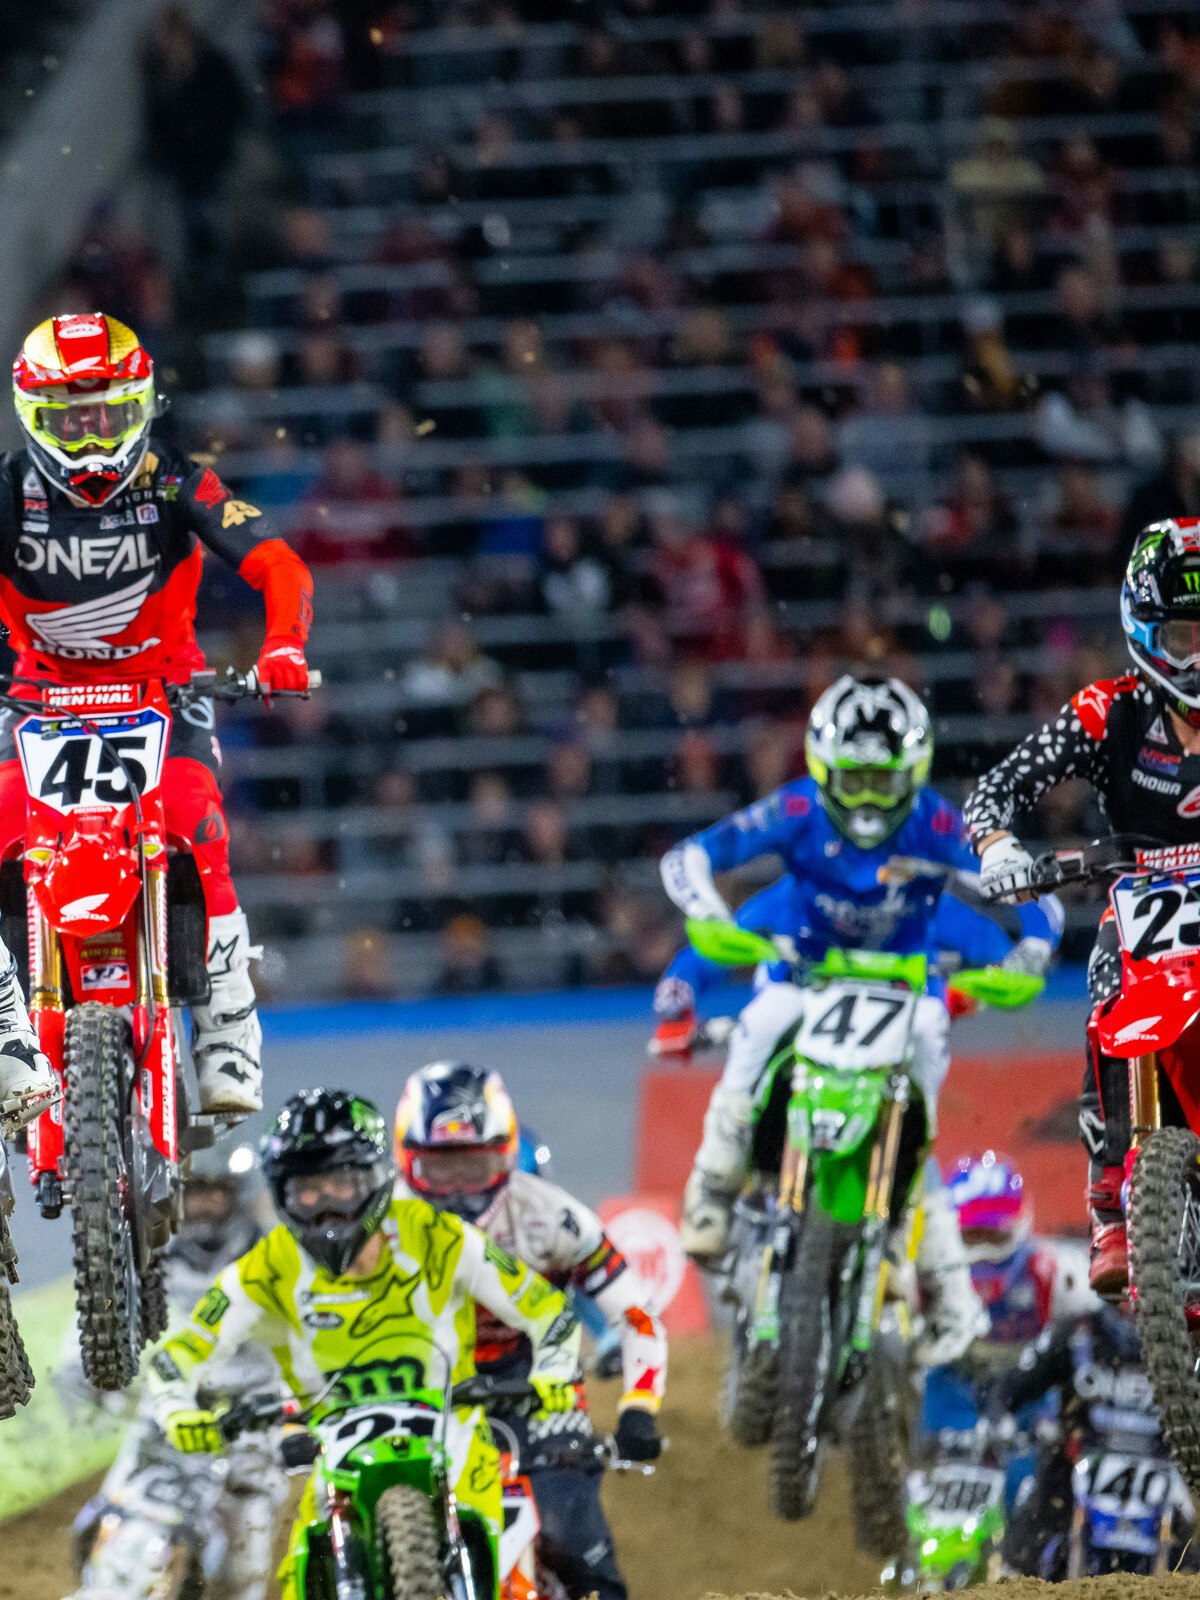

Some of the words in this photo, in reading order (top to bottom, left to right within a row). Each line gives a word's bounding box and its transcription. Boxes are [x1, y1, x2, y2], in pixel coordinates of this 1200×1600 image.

[49, 691, 134, 707] RENTHAL
[39, 735, 147, 808] 45
[811, 994, 907, 1047] 47
